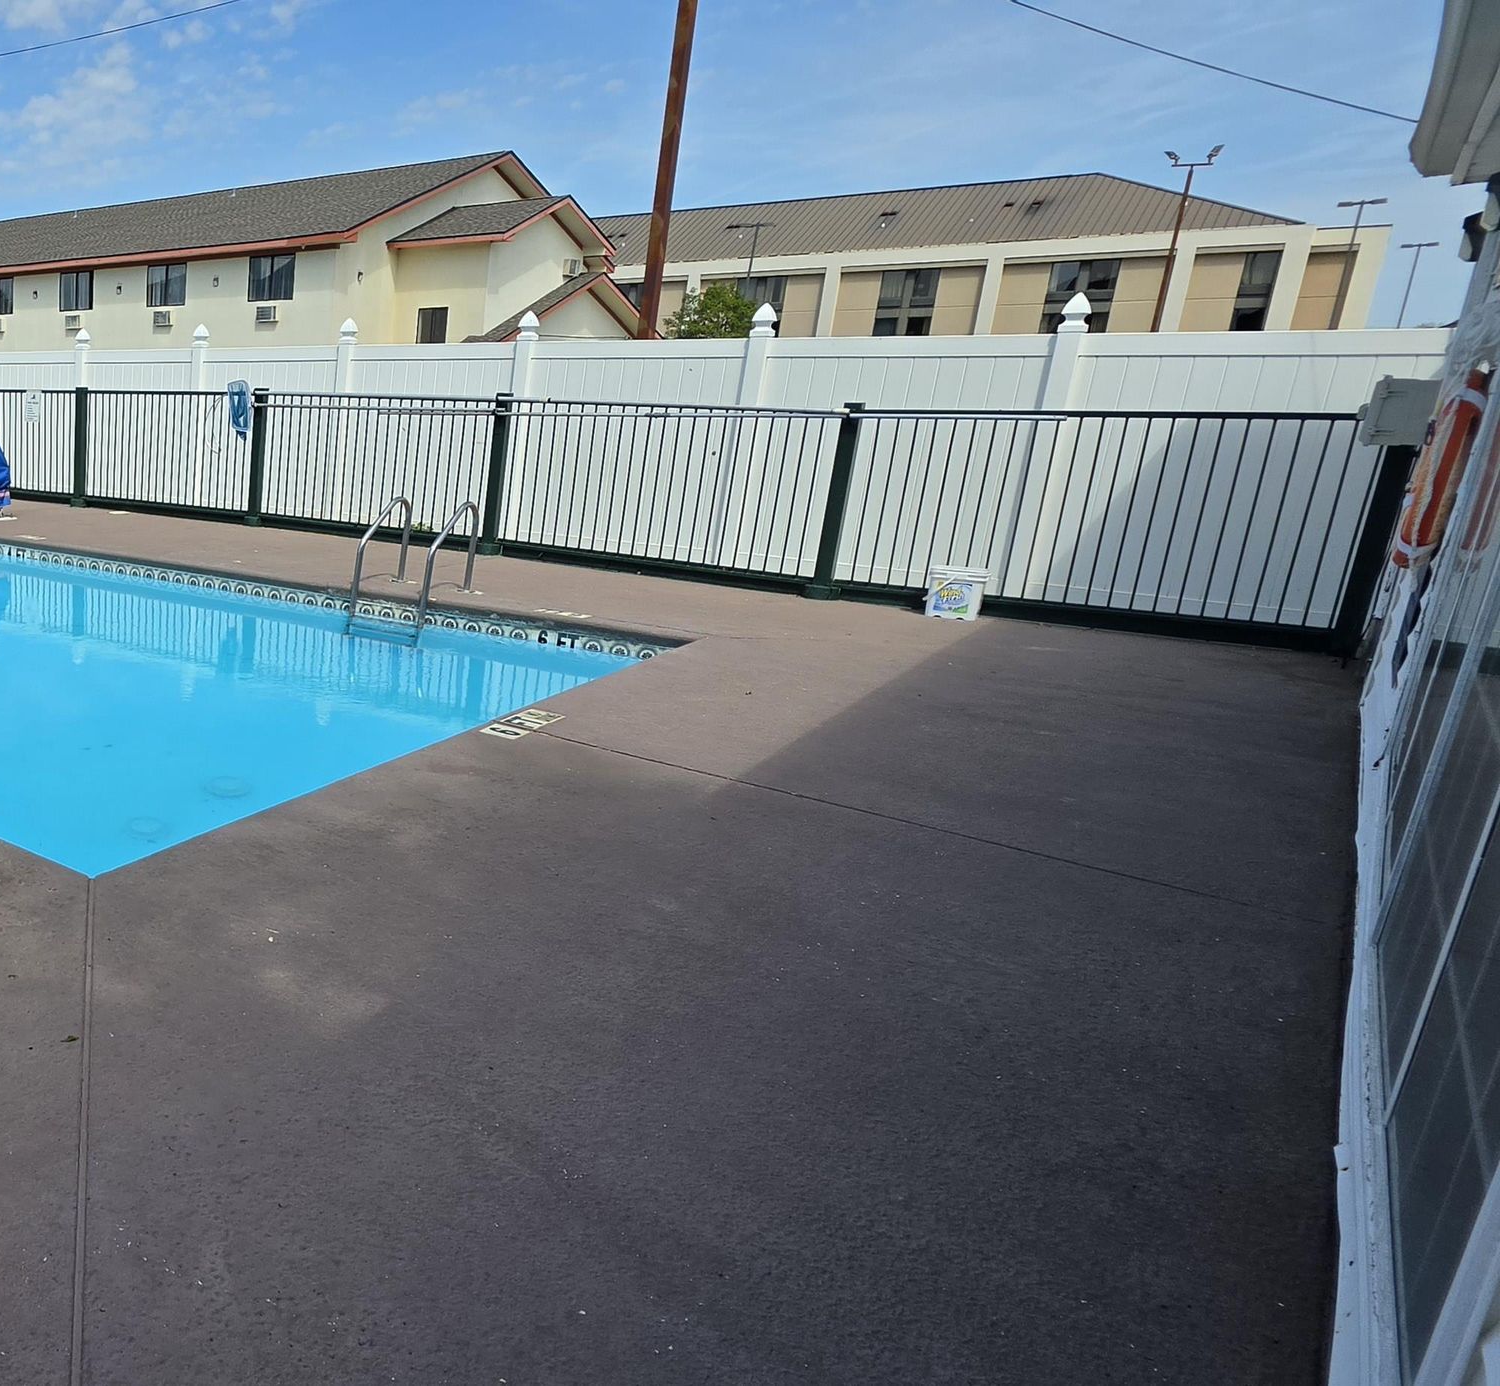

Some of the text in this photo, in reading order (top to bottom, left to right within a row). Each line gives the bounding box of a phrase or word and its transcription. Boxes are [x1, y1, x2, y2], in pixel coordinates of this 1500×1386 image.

[538, 630, 580, 649] 6 FT
[489, 727, 521, 736] 6
